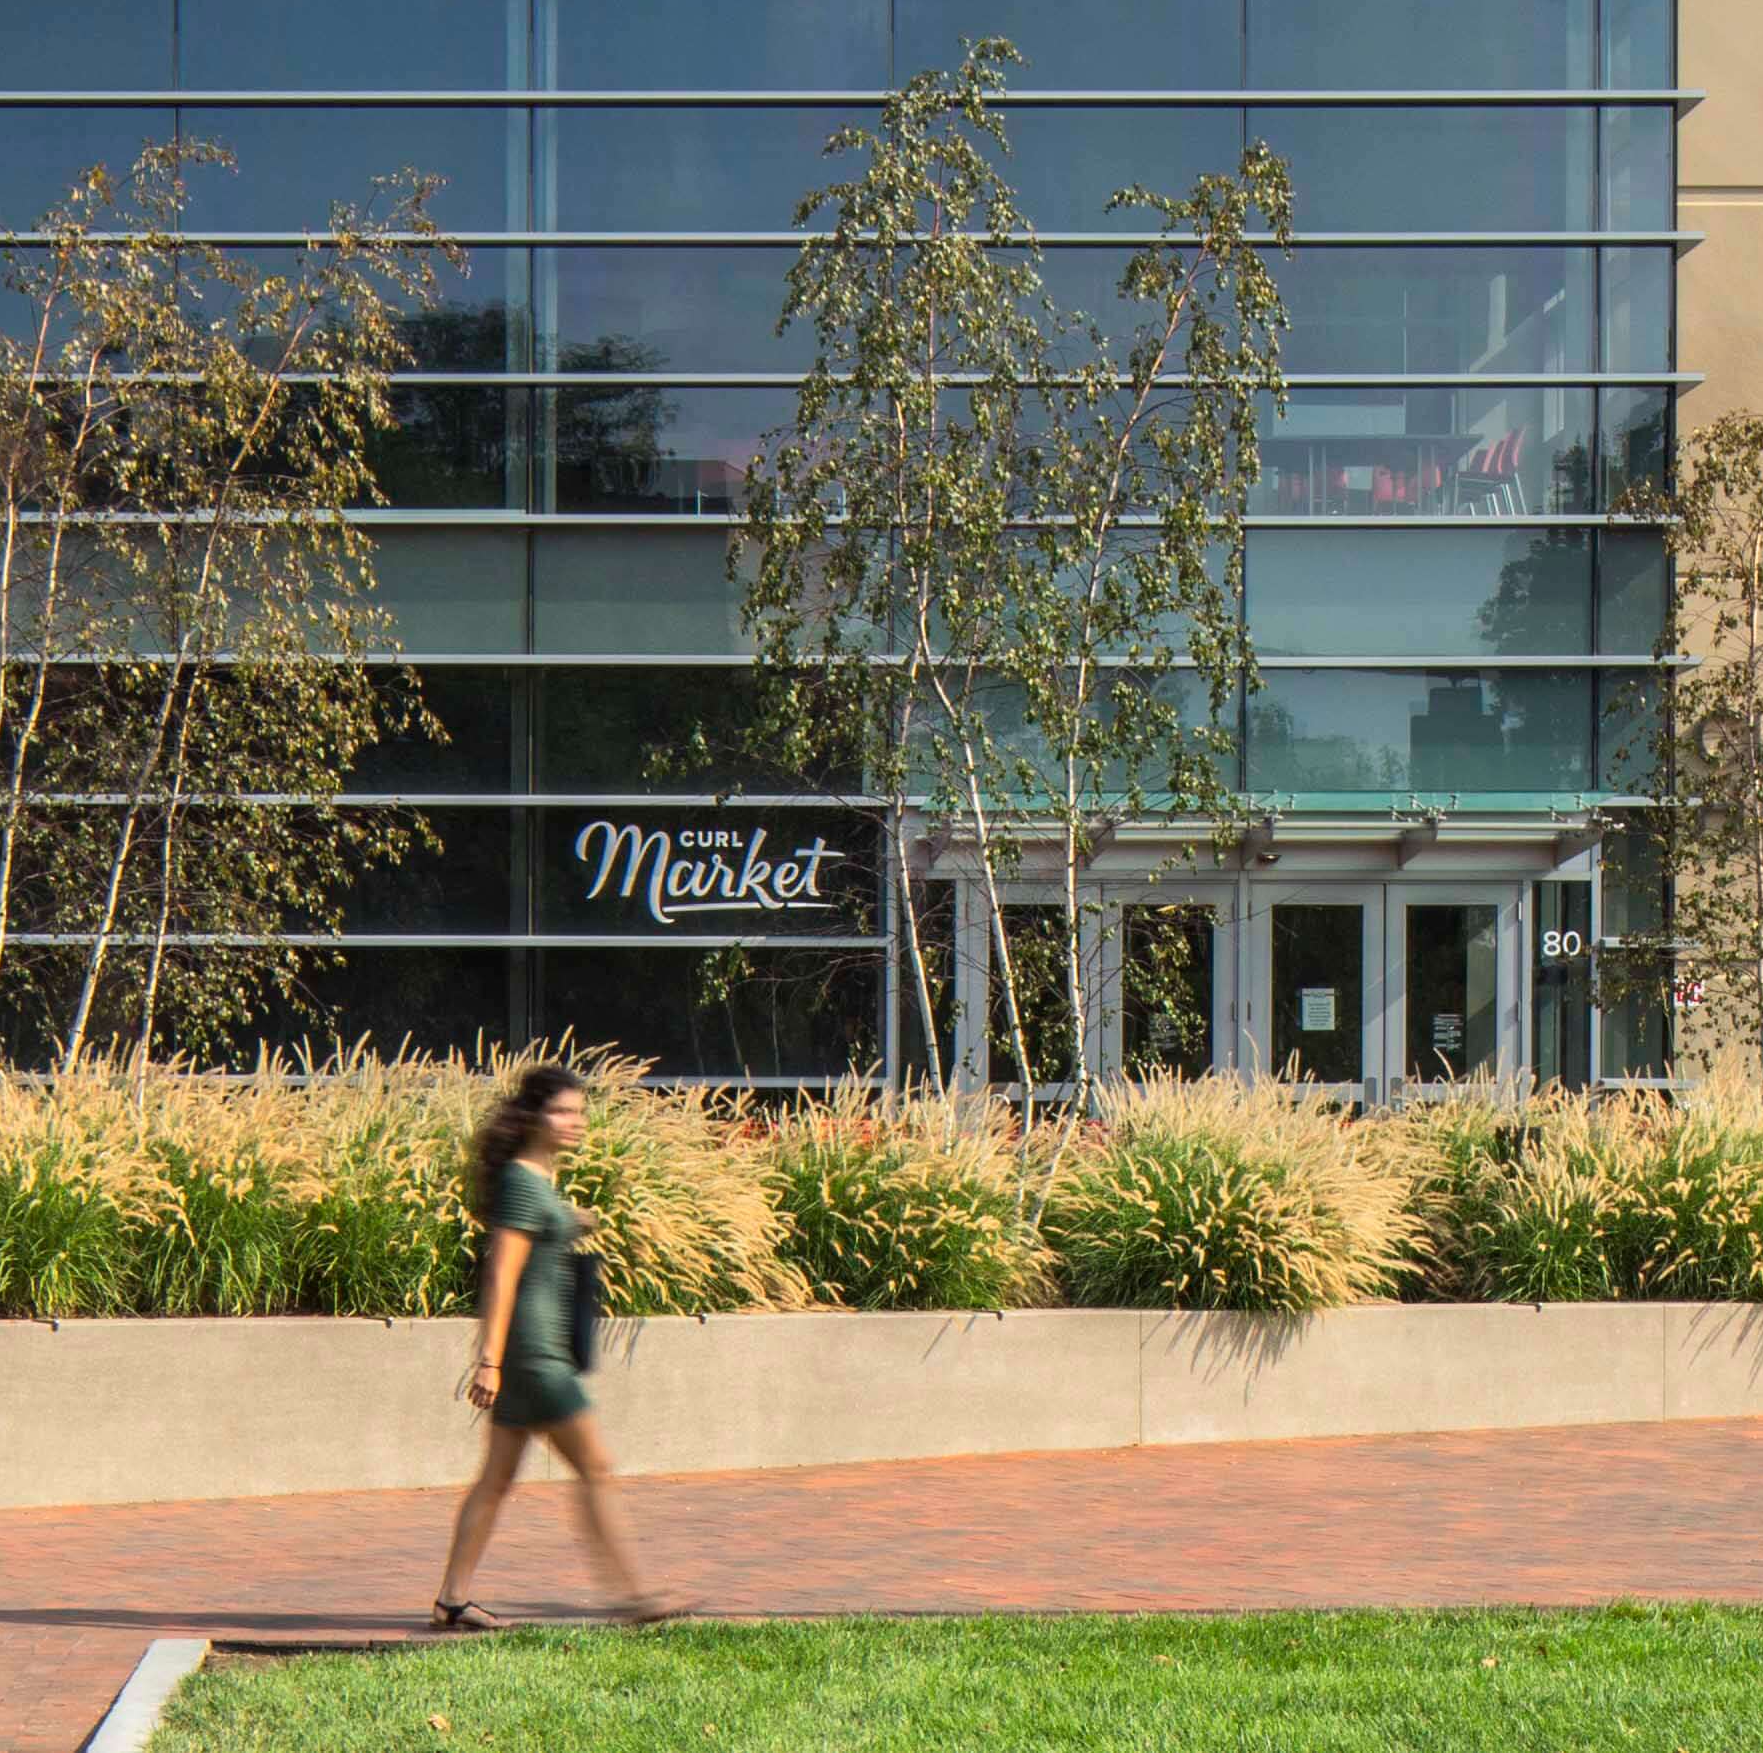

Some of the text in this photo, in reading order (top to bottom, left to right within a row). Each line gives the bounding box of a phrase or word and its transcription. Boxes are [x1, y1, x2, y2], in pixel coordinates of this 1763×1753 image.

[679, 830, 745, 848] CURL
[574, 820, 847, 924] Market
[1543, 930, 1582, 957] 80
